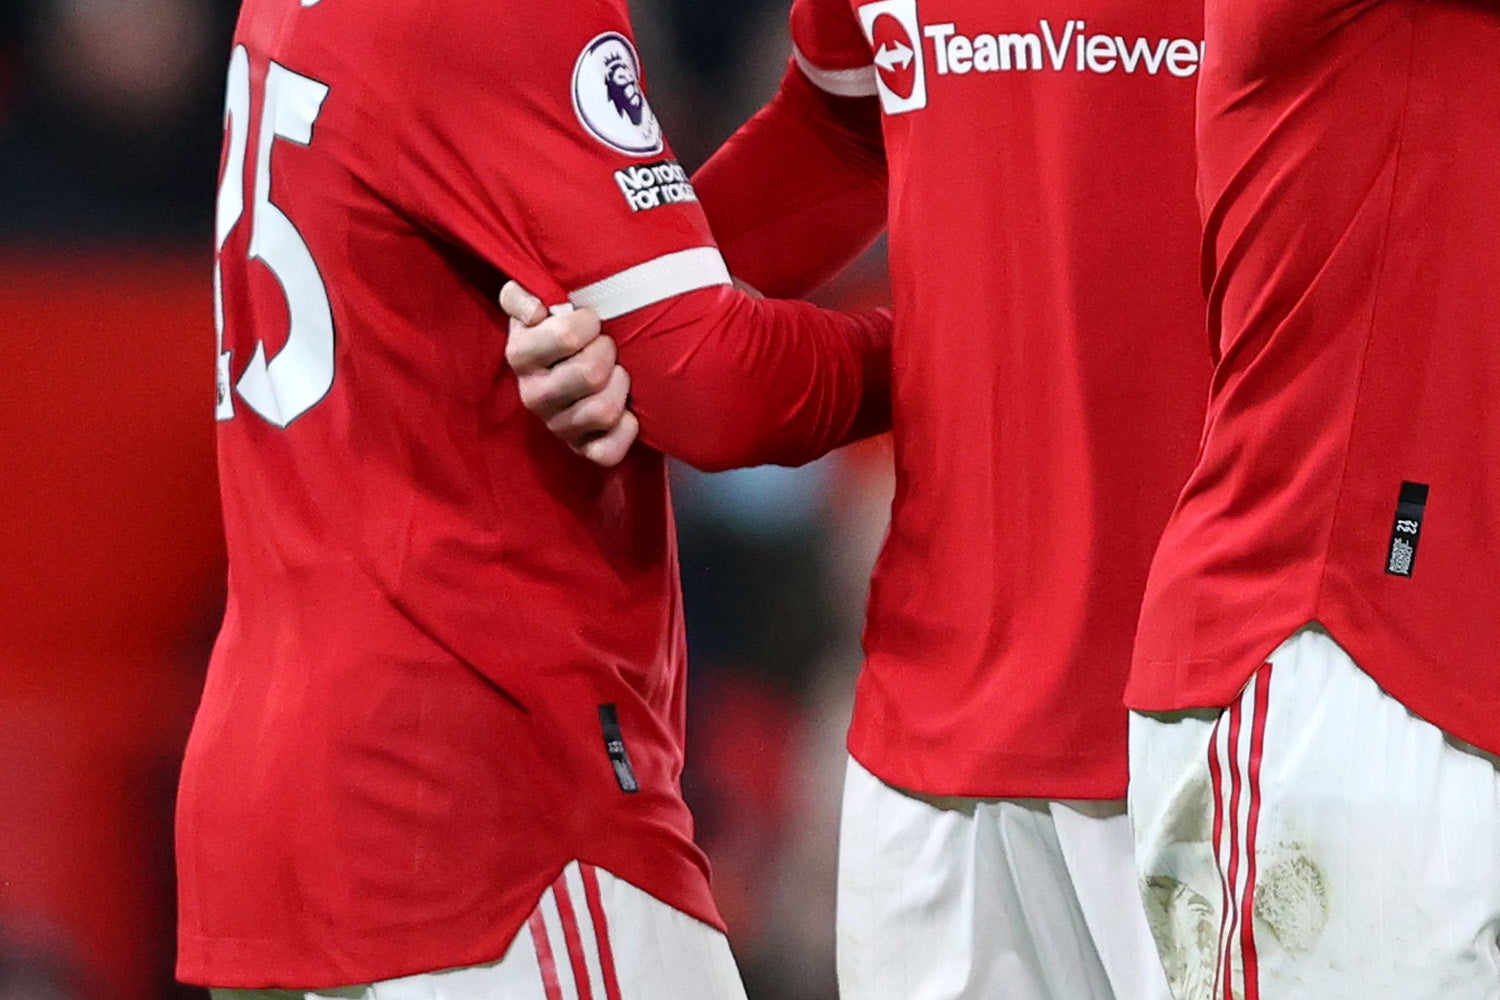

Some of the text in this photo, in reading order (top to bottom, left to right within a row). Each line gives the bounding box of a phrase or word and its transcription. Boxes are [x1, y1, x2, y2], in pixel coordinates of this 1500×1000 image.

[613, 165, 655, 194] No
[624, 186, 661, 213] for
[214, 42, 335, 429] 25
